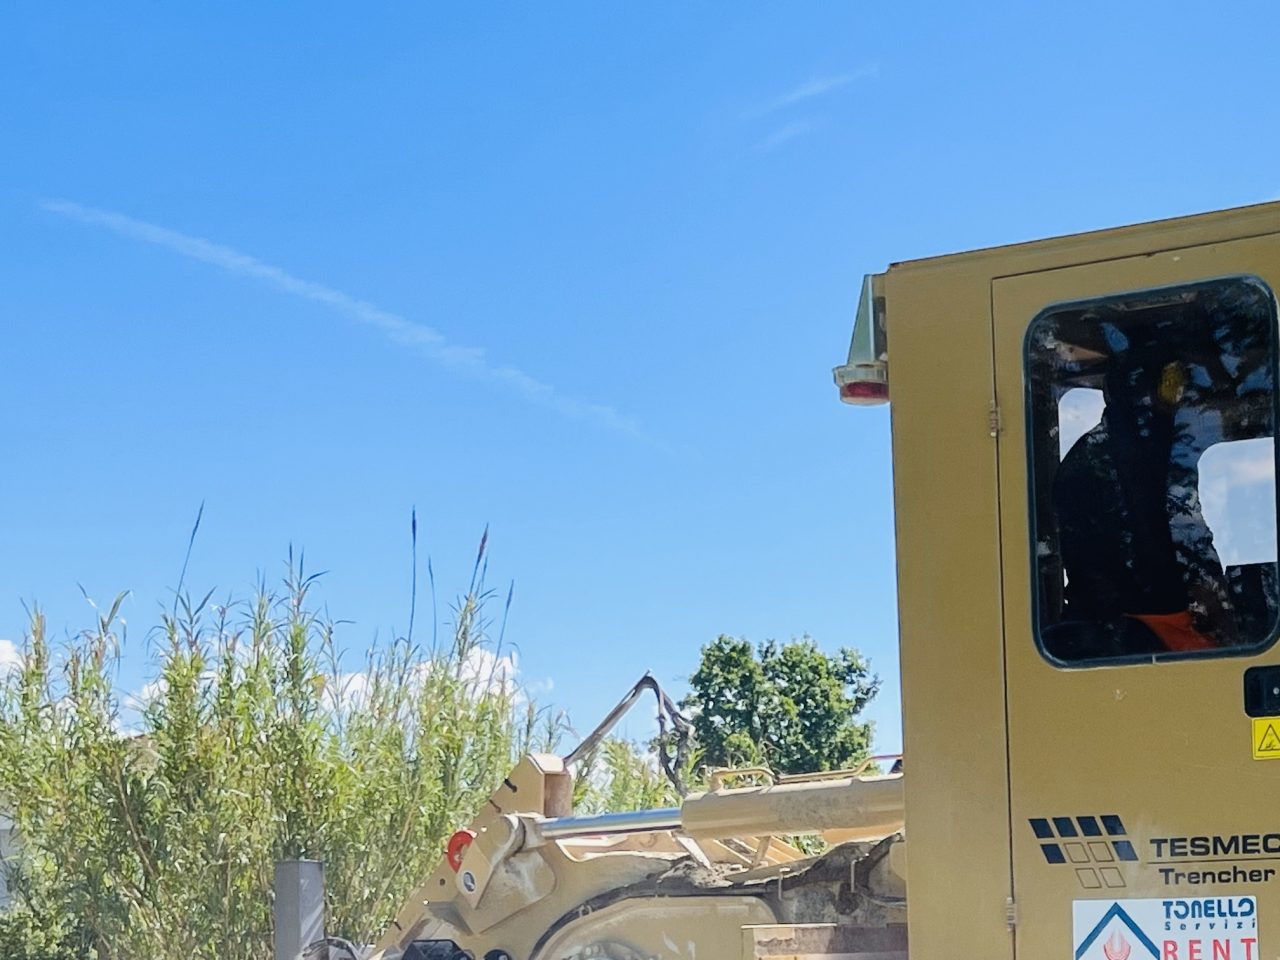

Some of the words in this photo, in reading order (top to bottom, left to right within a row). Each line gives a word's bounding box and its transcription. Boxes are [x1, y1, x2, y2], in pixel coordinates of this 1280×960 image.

[1158, 865, 1276, 885] Trencher
[1162, 898, 1255, 919] TONELLO
[1164, 918, 1256, 931] Servizi
